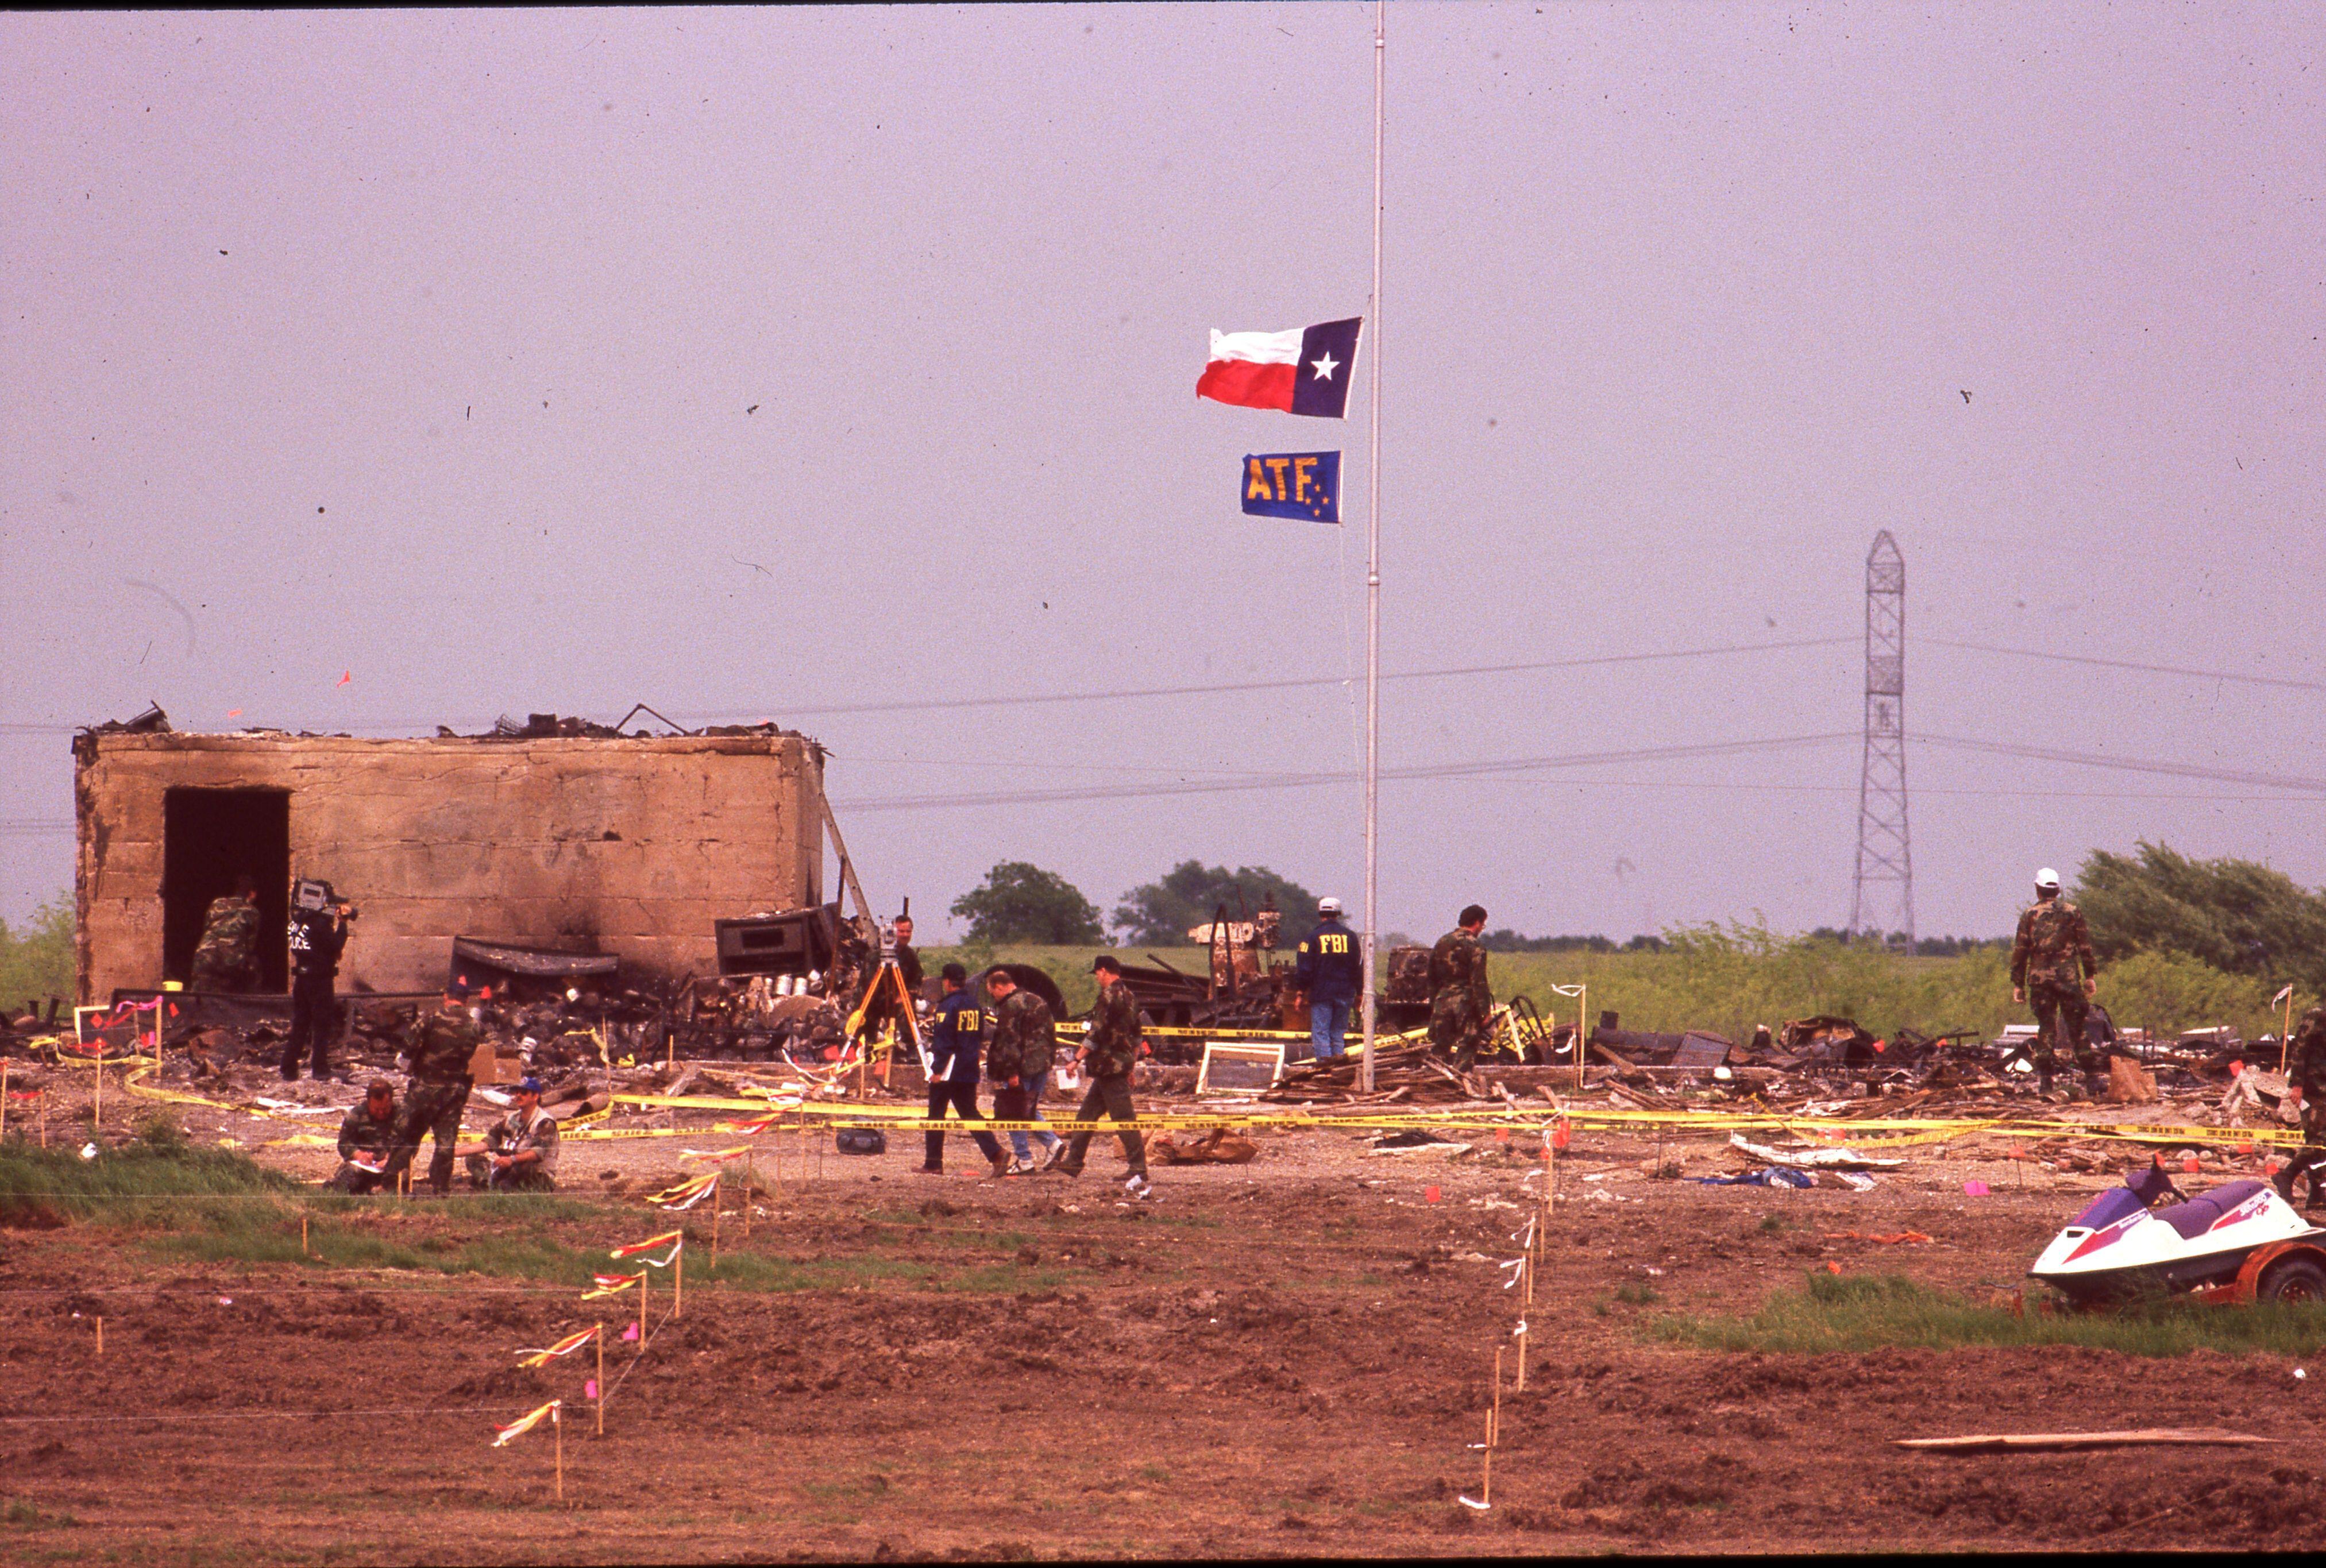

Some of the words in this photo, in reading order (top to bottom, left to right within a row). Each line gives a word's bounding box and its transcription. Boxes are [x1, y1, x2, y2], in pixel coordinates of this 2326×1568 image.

[1247, 457, 1318, 501] ATF
[1319, 934, 1348, 953] FBI
[958, 1010, 979, 1032] FBI
